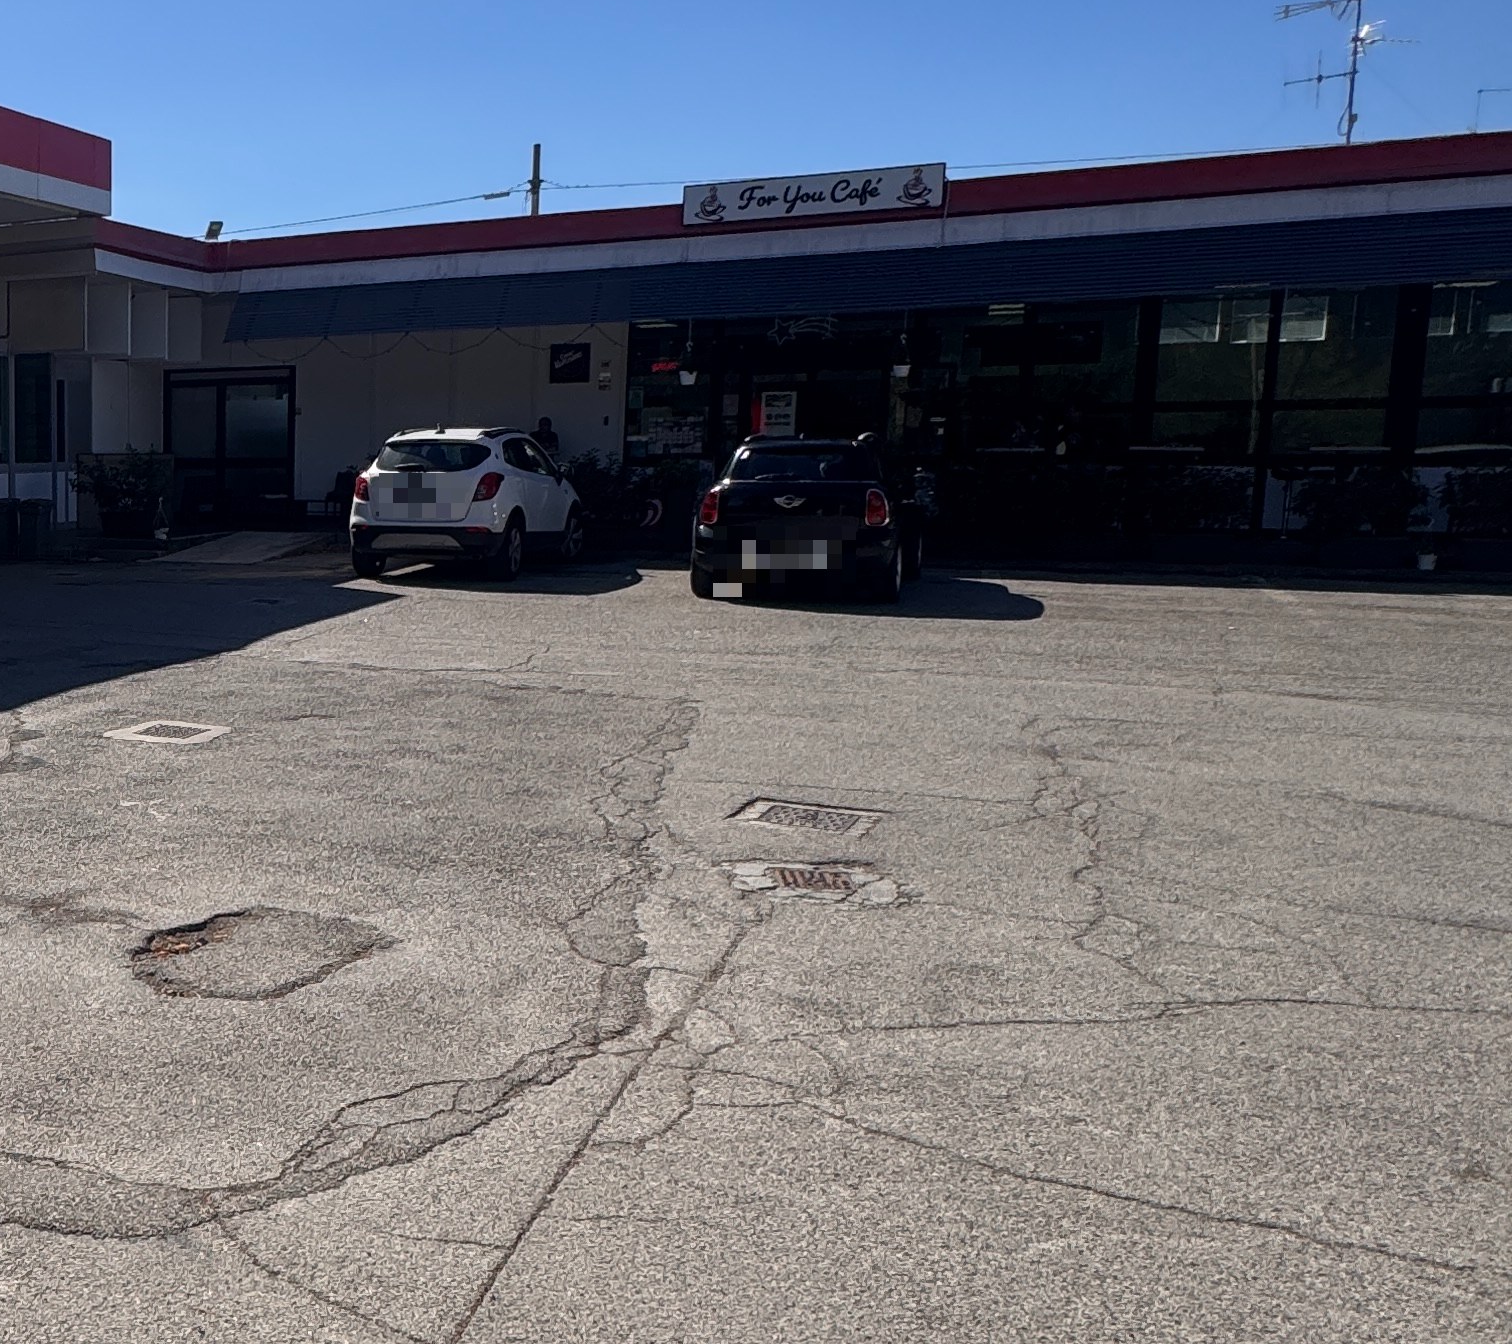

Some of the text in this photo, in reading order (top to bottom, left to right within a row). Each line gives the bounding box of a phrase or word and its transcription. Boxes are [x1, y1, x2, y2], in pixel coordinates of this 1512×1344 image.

[737, 177, 883, 214] For You Café
